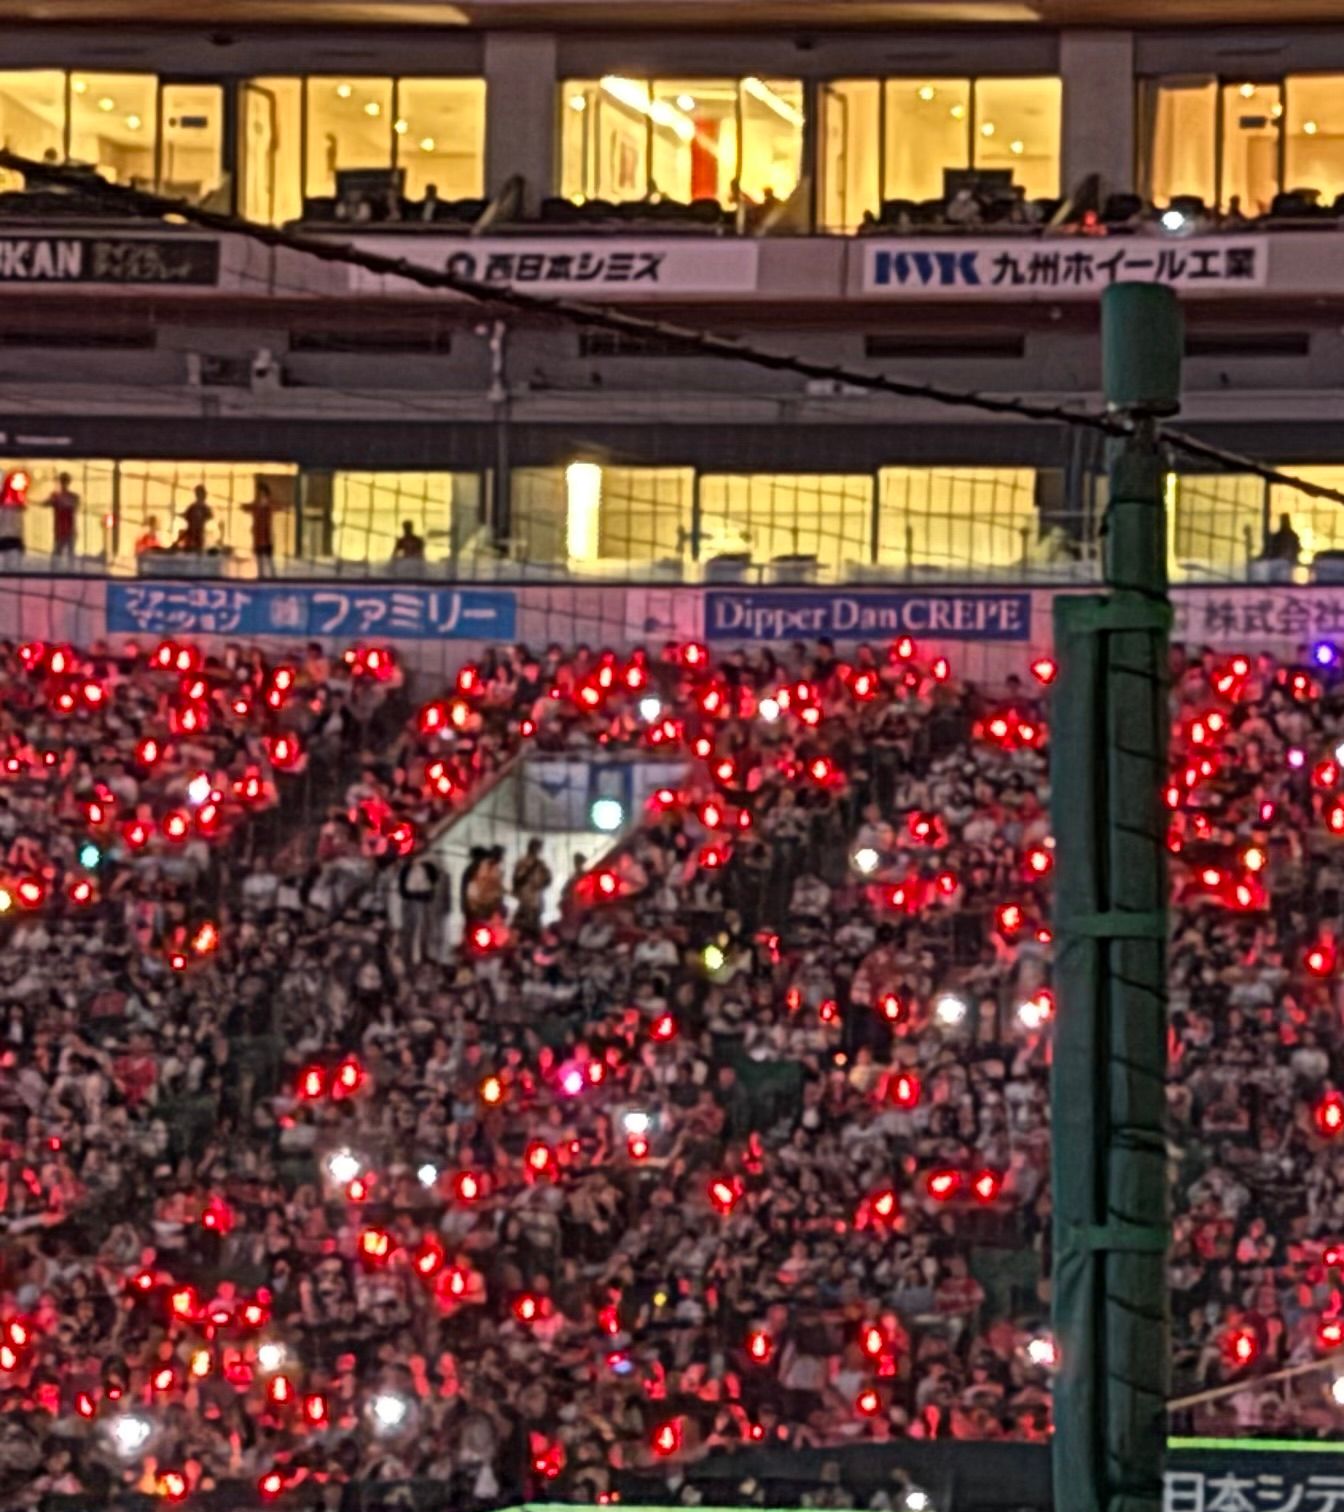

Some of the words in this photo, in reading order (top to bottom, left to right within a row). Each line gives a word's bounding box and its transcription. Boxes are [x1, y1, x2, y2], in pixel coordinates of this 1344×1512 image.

[0, 240, 83, 278] KAN
[991, 247, 1257, 286] 九州ホイール工業
[312, 592, 497, 632] ファミリー
[716, 599, 825, 637] Dipper
[832, 599, 897, 630] Dan
[901, 598, 1021, 631] CREPE
